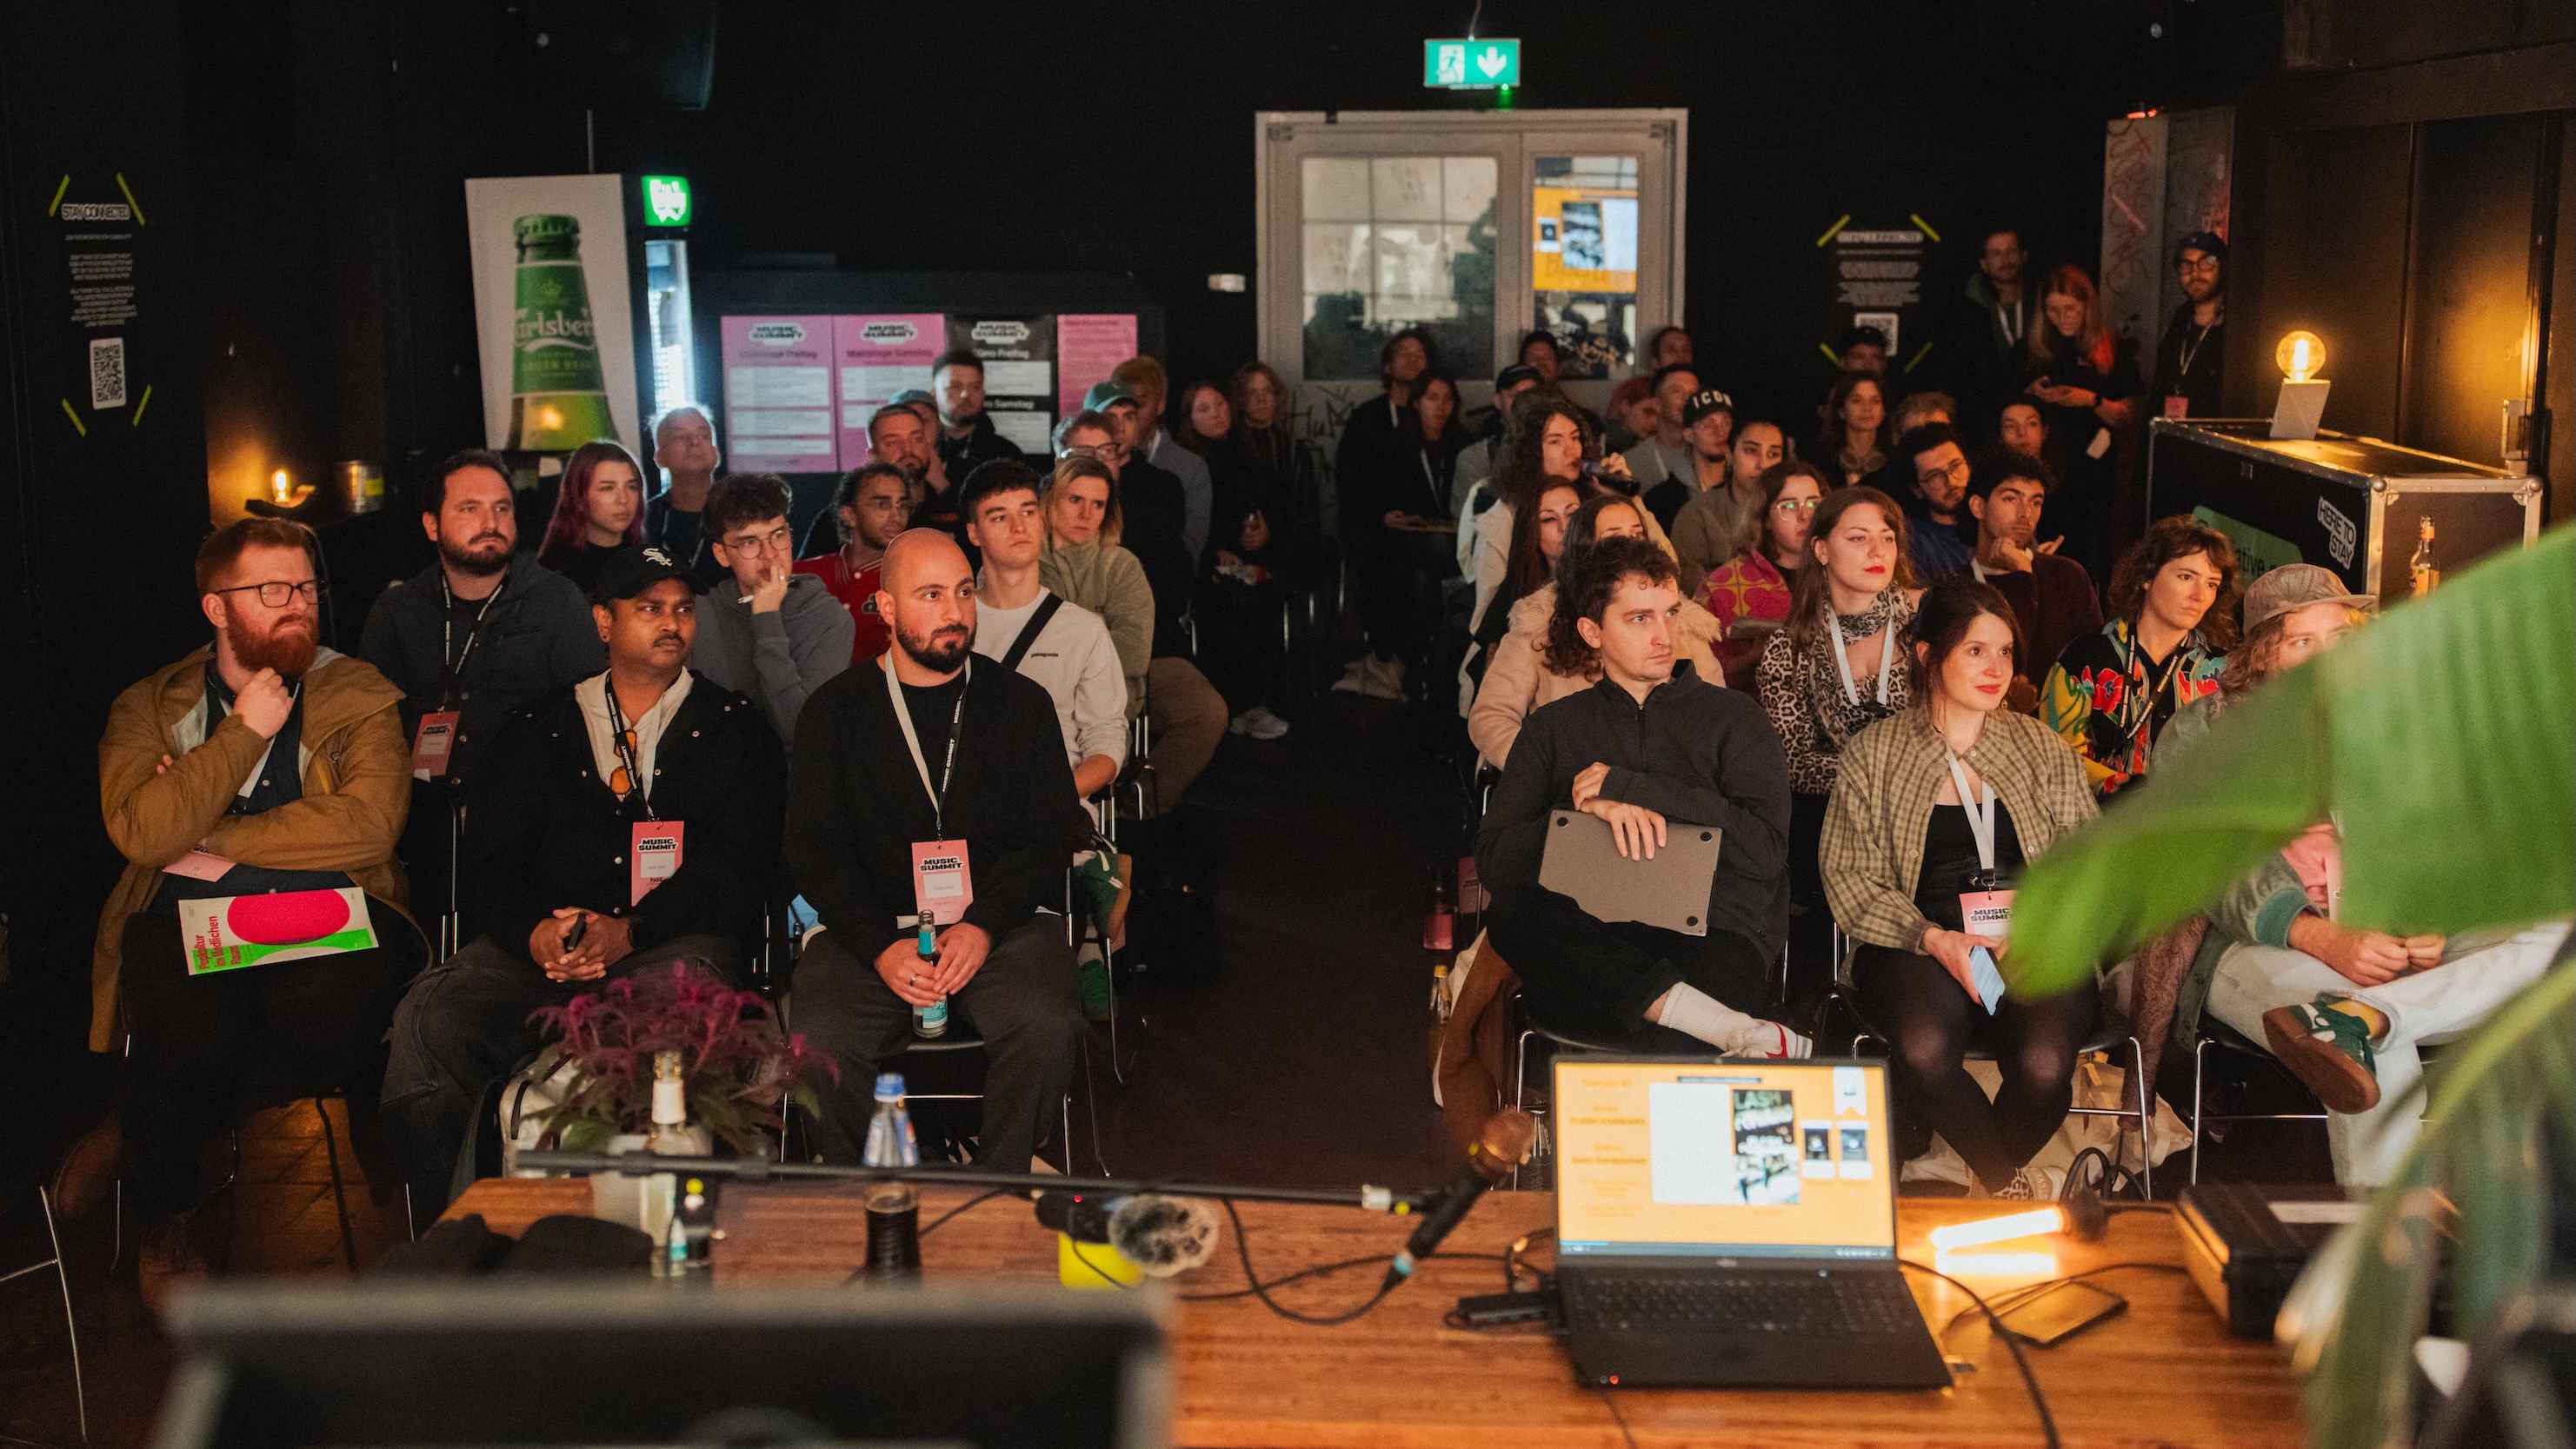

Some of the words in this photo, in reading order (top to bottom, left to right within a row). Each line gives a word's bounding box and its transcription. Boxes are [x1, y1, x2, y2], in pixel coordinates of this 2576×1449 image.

[2319, 507, 2342, 533] HERE
[2343, 522, 2355, 545] TO
[2331, 535, 2353, 563] STAY
[920, 862, 962, 871] SUMMIT
